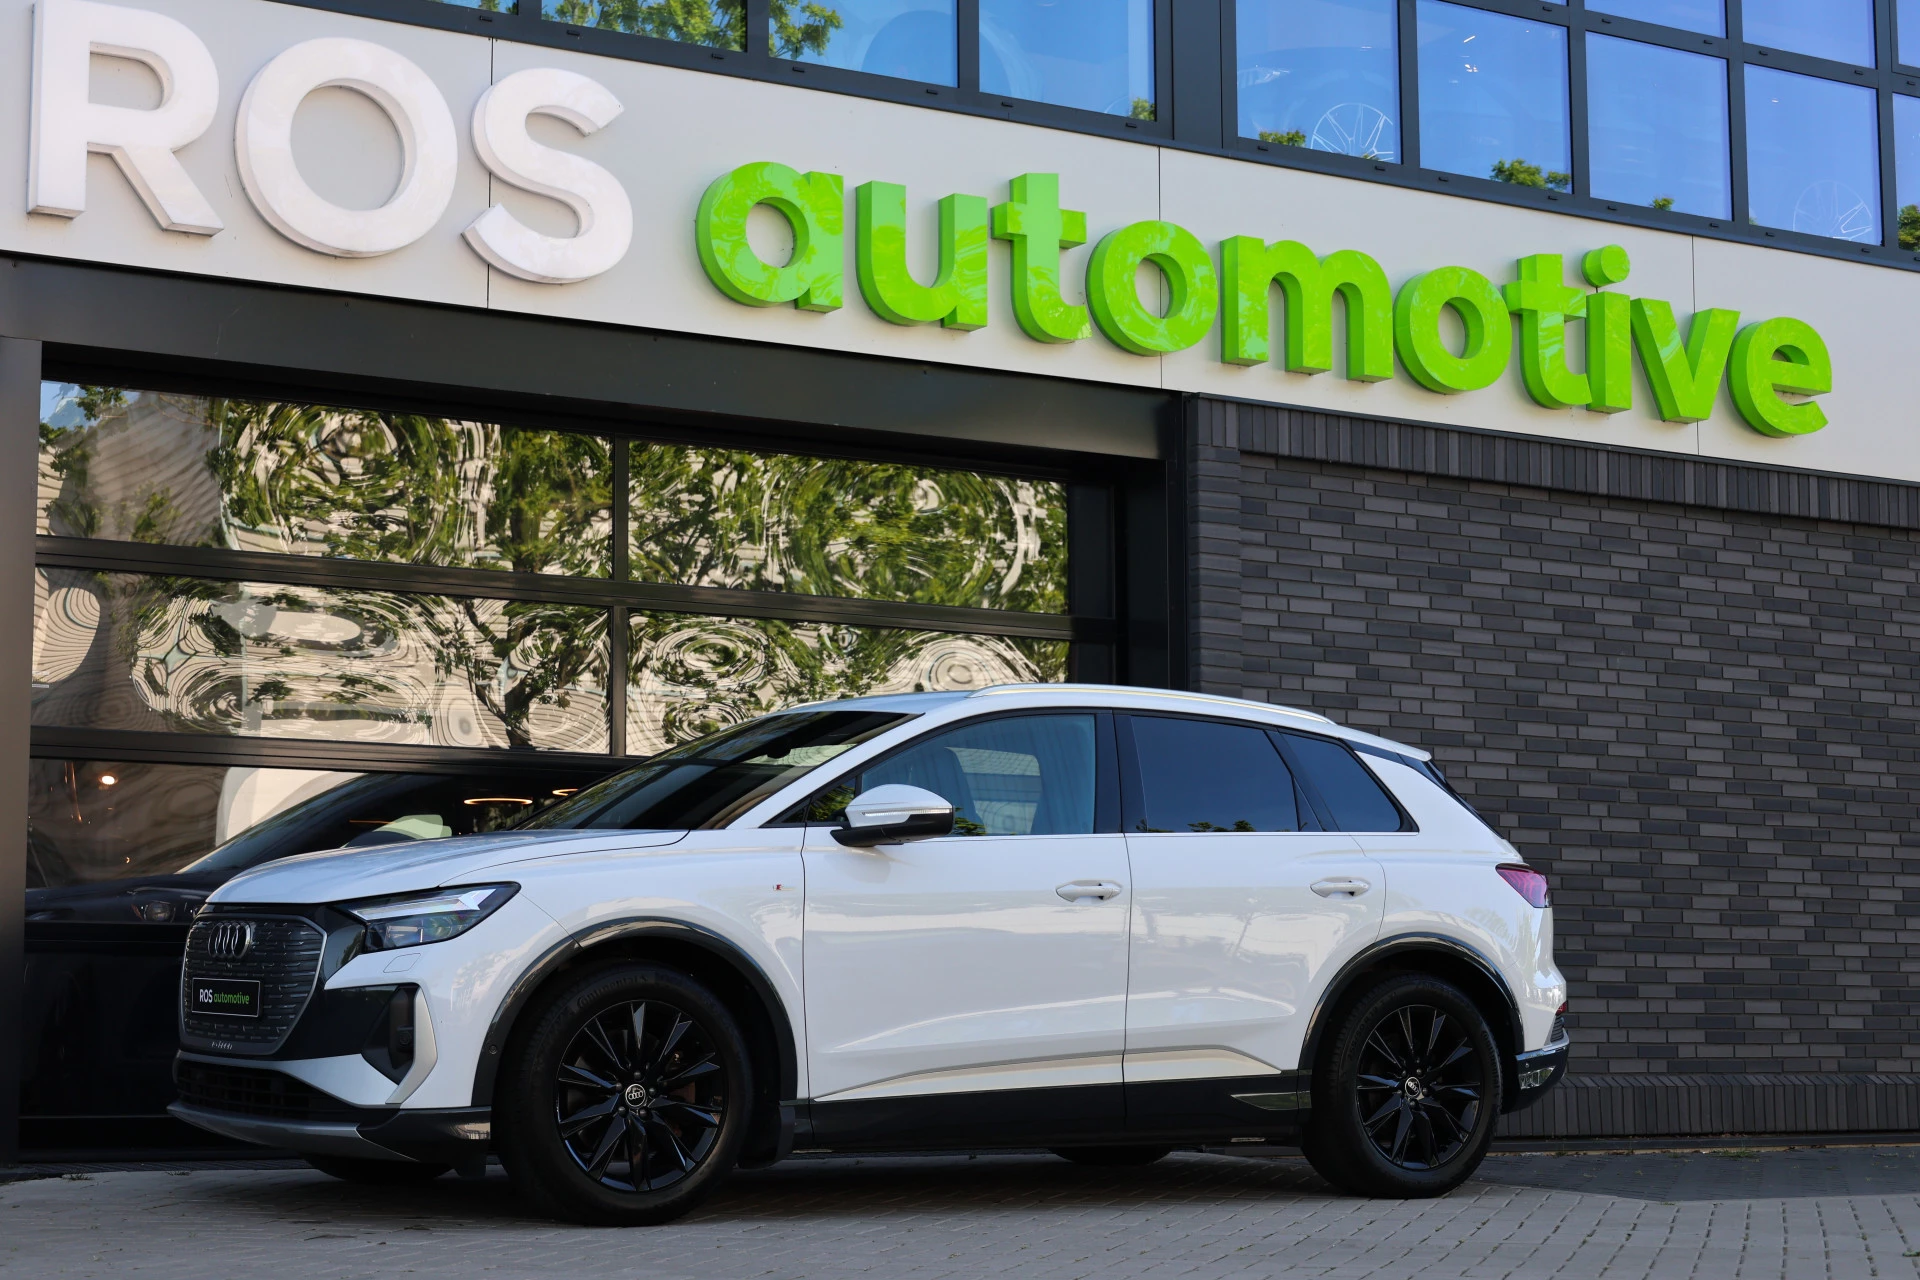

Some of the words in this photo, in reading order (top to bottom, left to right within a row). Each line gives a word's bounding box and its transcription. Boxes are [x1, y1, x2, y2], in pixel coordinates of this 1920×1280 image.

[27, 0, 634, 285] ROS
[695, 161, 1832, 438] automotive
[199, 988, 213, 1003] ROS
[213, 991, 250, 1004] automotive
